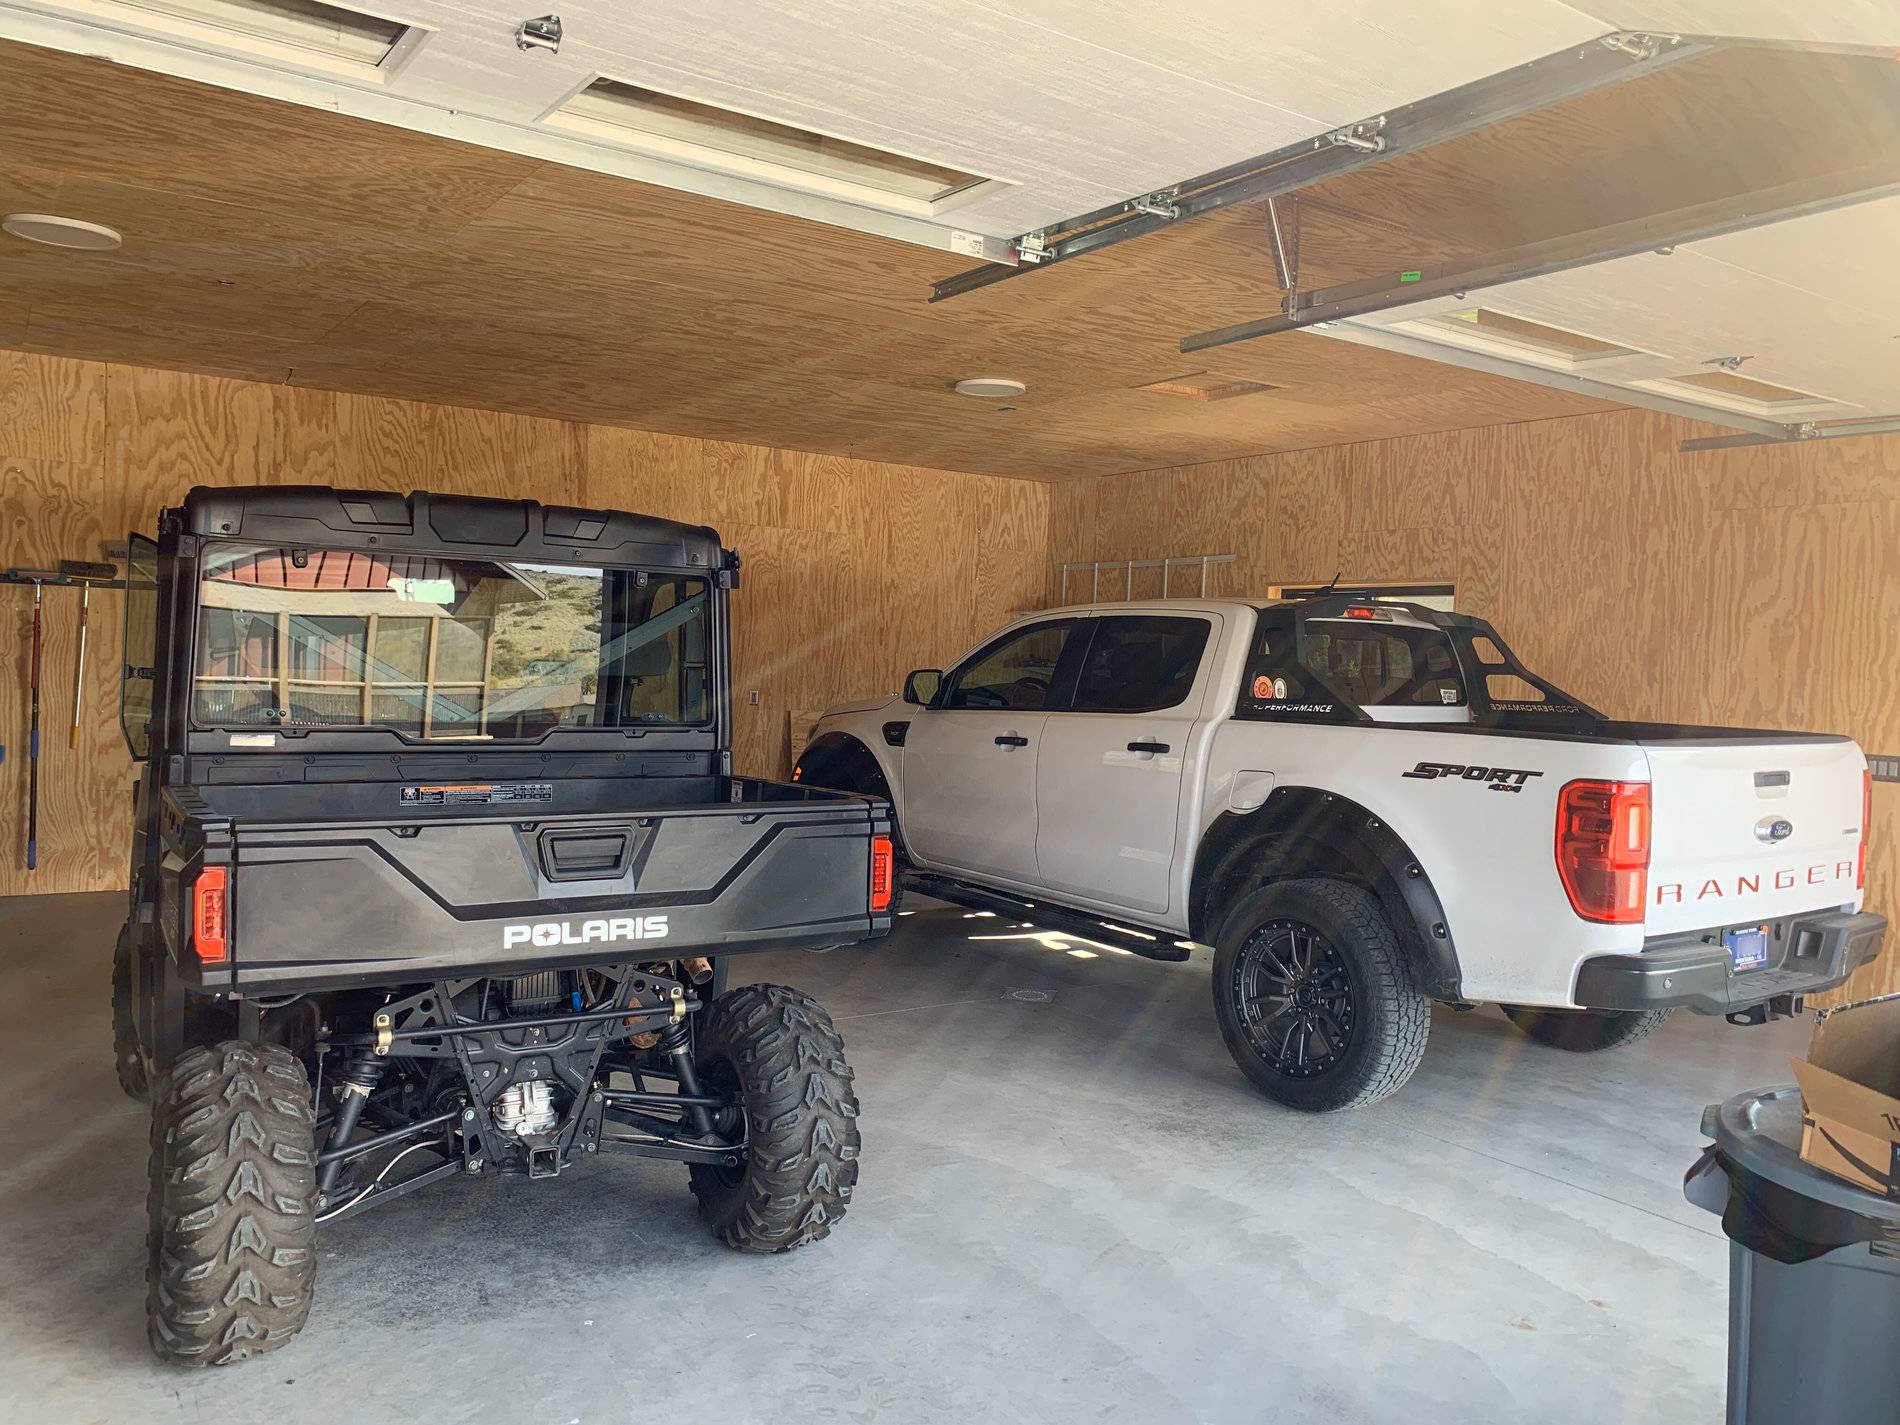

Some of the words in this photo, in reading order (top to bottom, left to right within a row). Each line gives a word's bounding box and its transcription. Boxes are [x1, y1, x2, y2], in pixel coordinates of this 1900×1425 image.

[1264, 704, 1333, 713] PERFORMANCE
[1401, 762, 1544, 785] SPORT
[1656, 861, 1852, 904] RANGER
[503, 915, 669, 949] POLARIS
